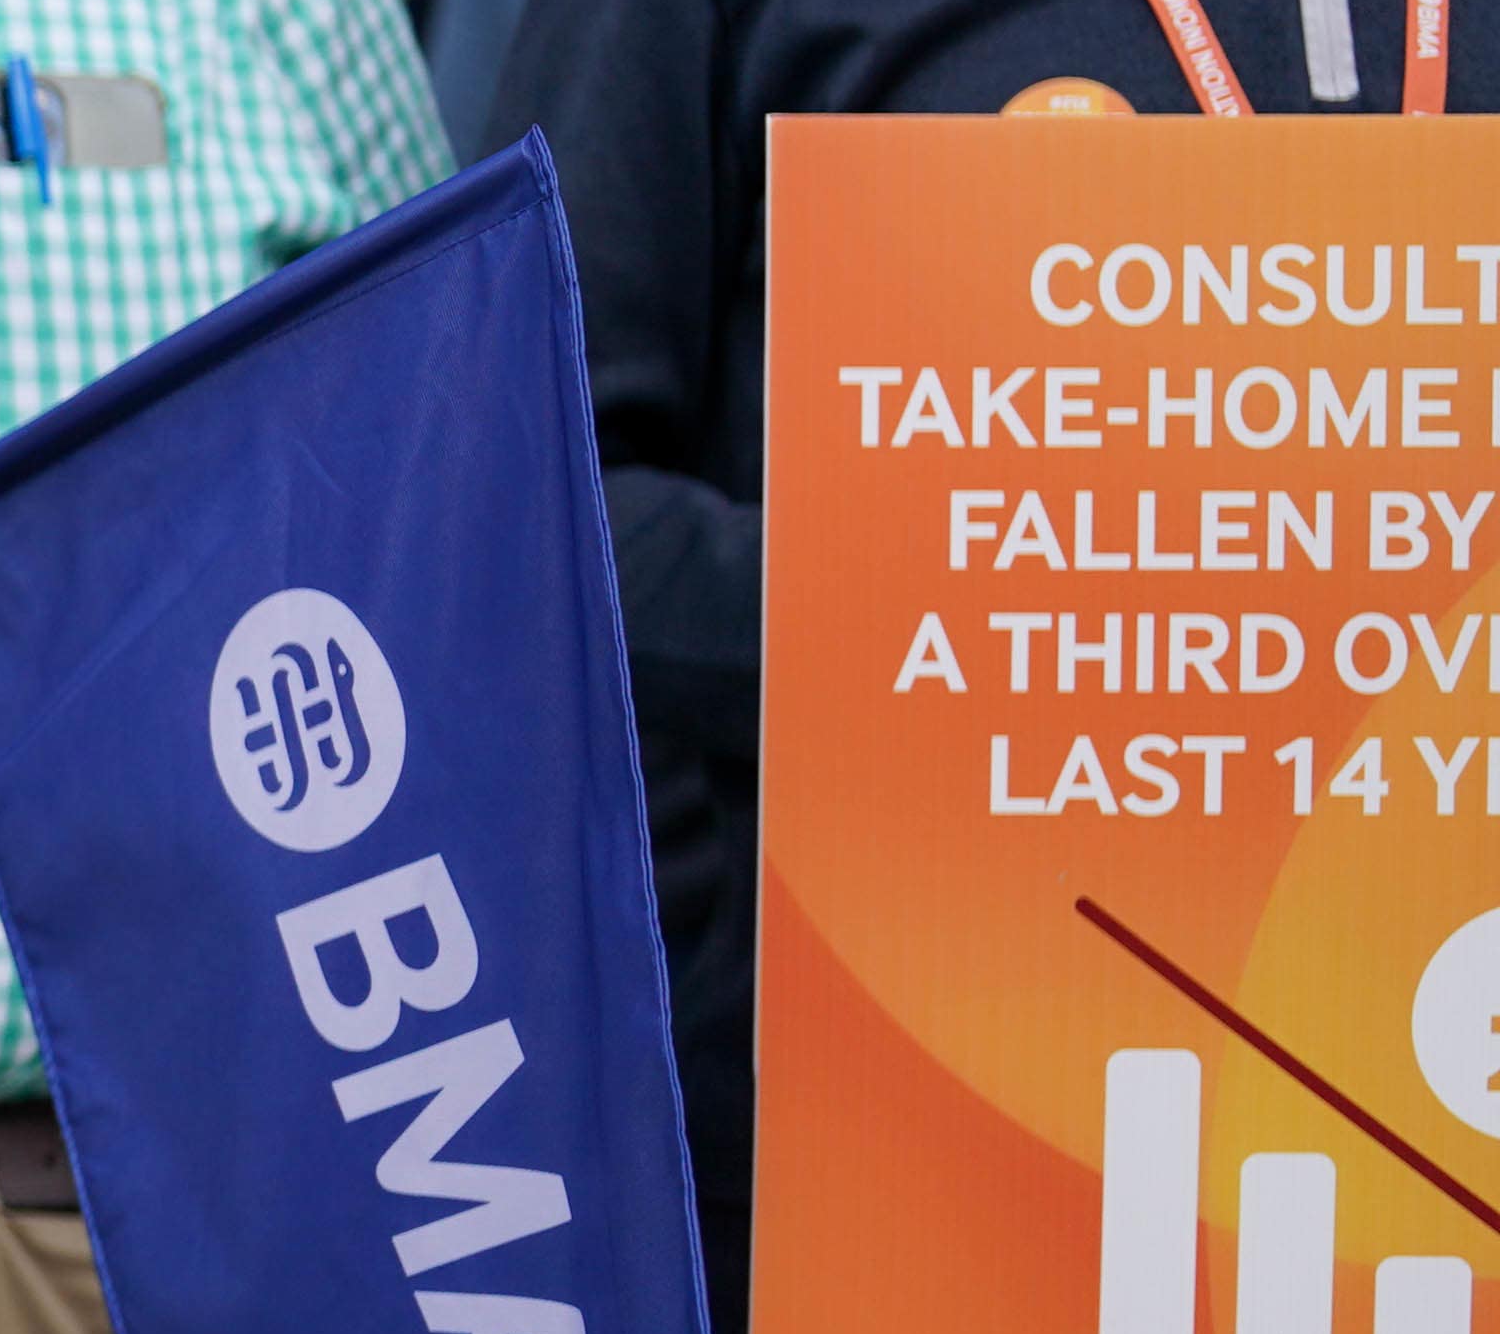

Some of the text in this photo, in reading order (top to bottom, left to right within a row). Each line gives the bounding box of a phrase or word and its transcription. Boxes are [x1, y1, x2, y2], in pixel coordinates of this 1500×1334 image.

[1416, 4, 1440, 60] BMA
[1031, 244, 1500, 325] CONSULT
[840, 367, 1461, 448] TAKE-HOME
[950, 491, 1495, 570] FALLEN BY
[895, 613, 1500, 693] A THIRD OV
[991, 735, 1500, 815] LAST 14 Y
